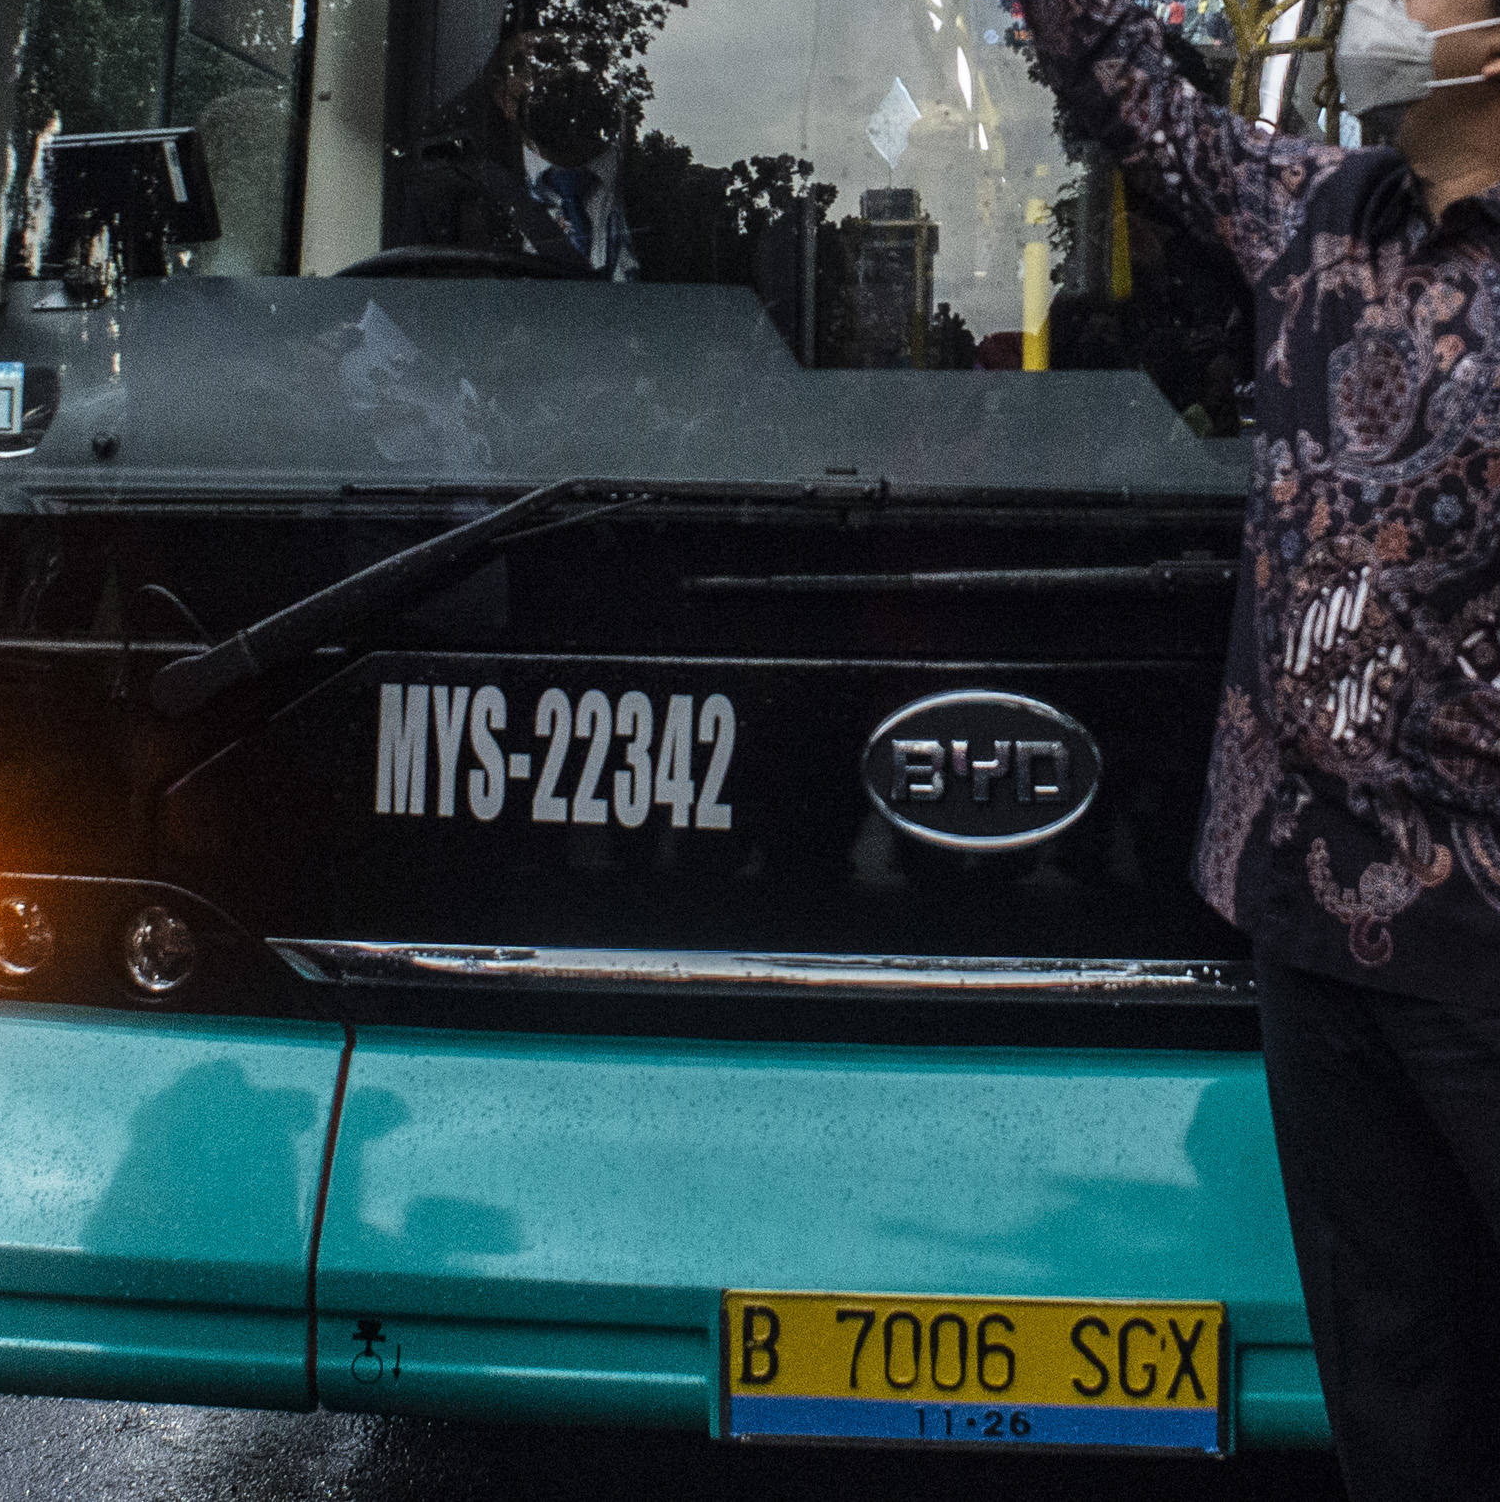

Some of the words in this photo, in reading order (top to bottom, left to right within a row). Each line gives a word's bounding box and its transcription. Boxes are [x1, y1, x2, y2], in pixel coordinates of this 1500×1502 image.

[374, 682, 737, 830] MYS-22342
[891, 739, 1070, 801] BYD
[740, 1305, 782, 1385] B
[835, 1309, 1016, 1393] 7006
[1070, 1314, 1206, 1401] SGX
